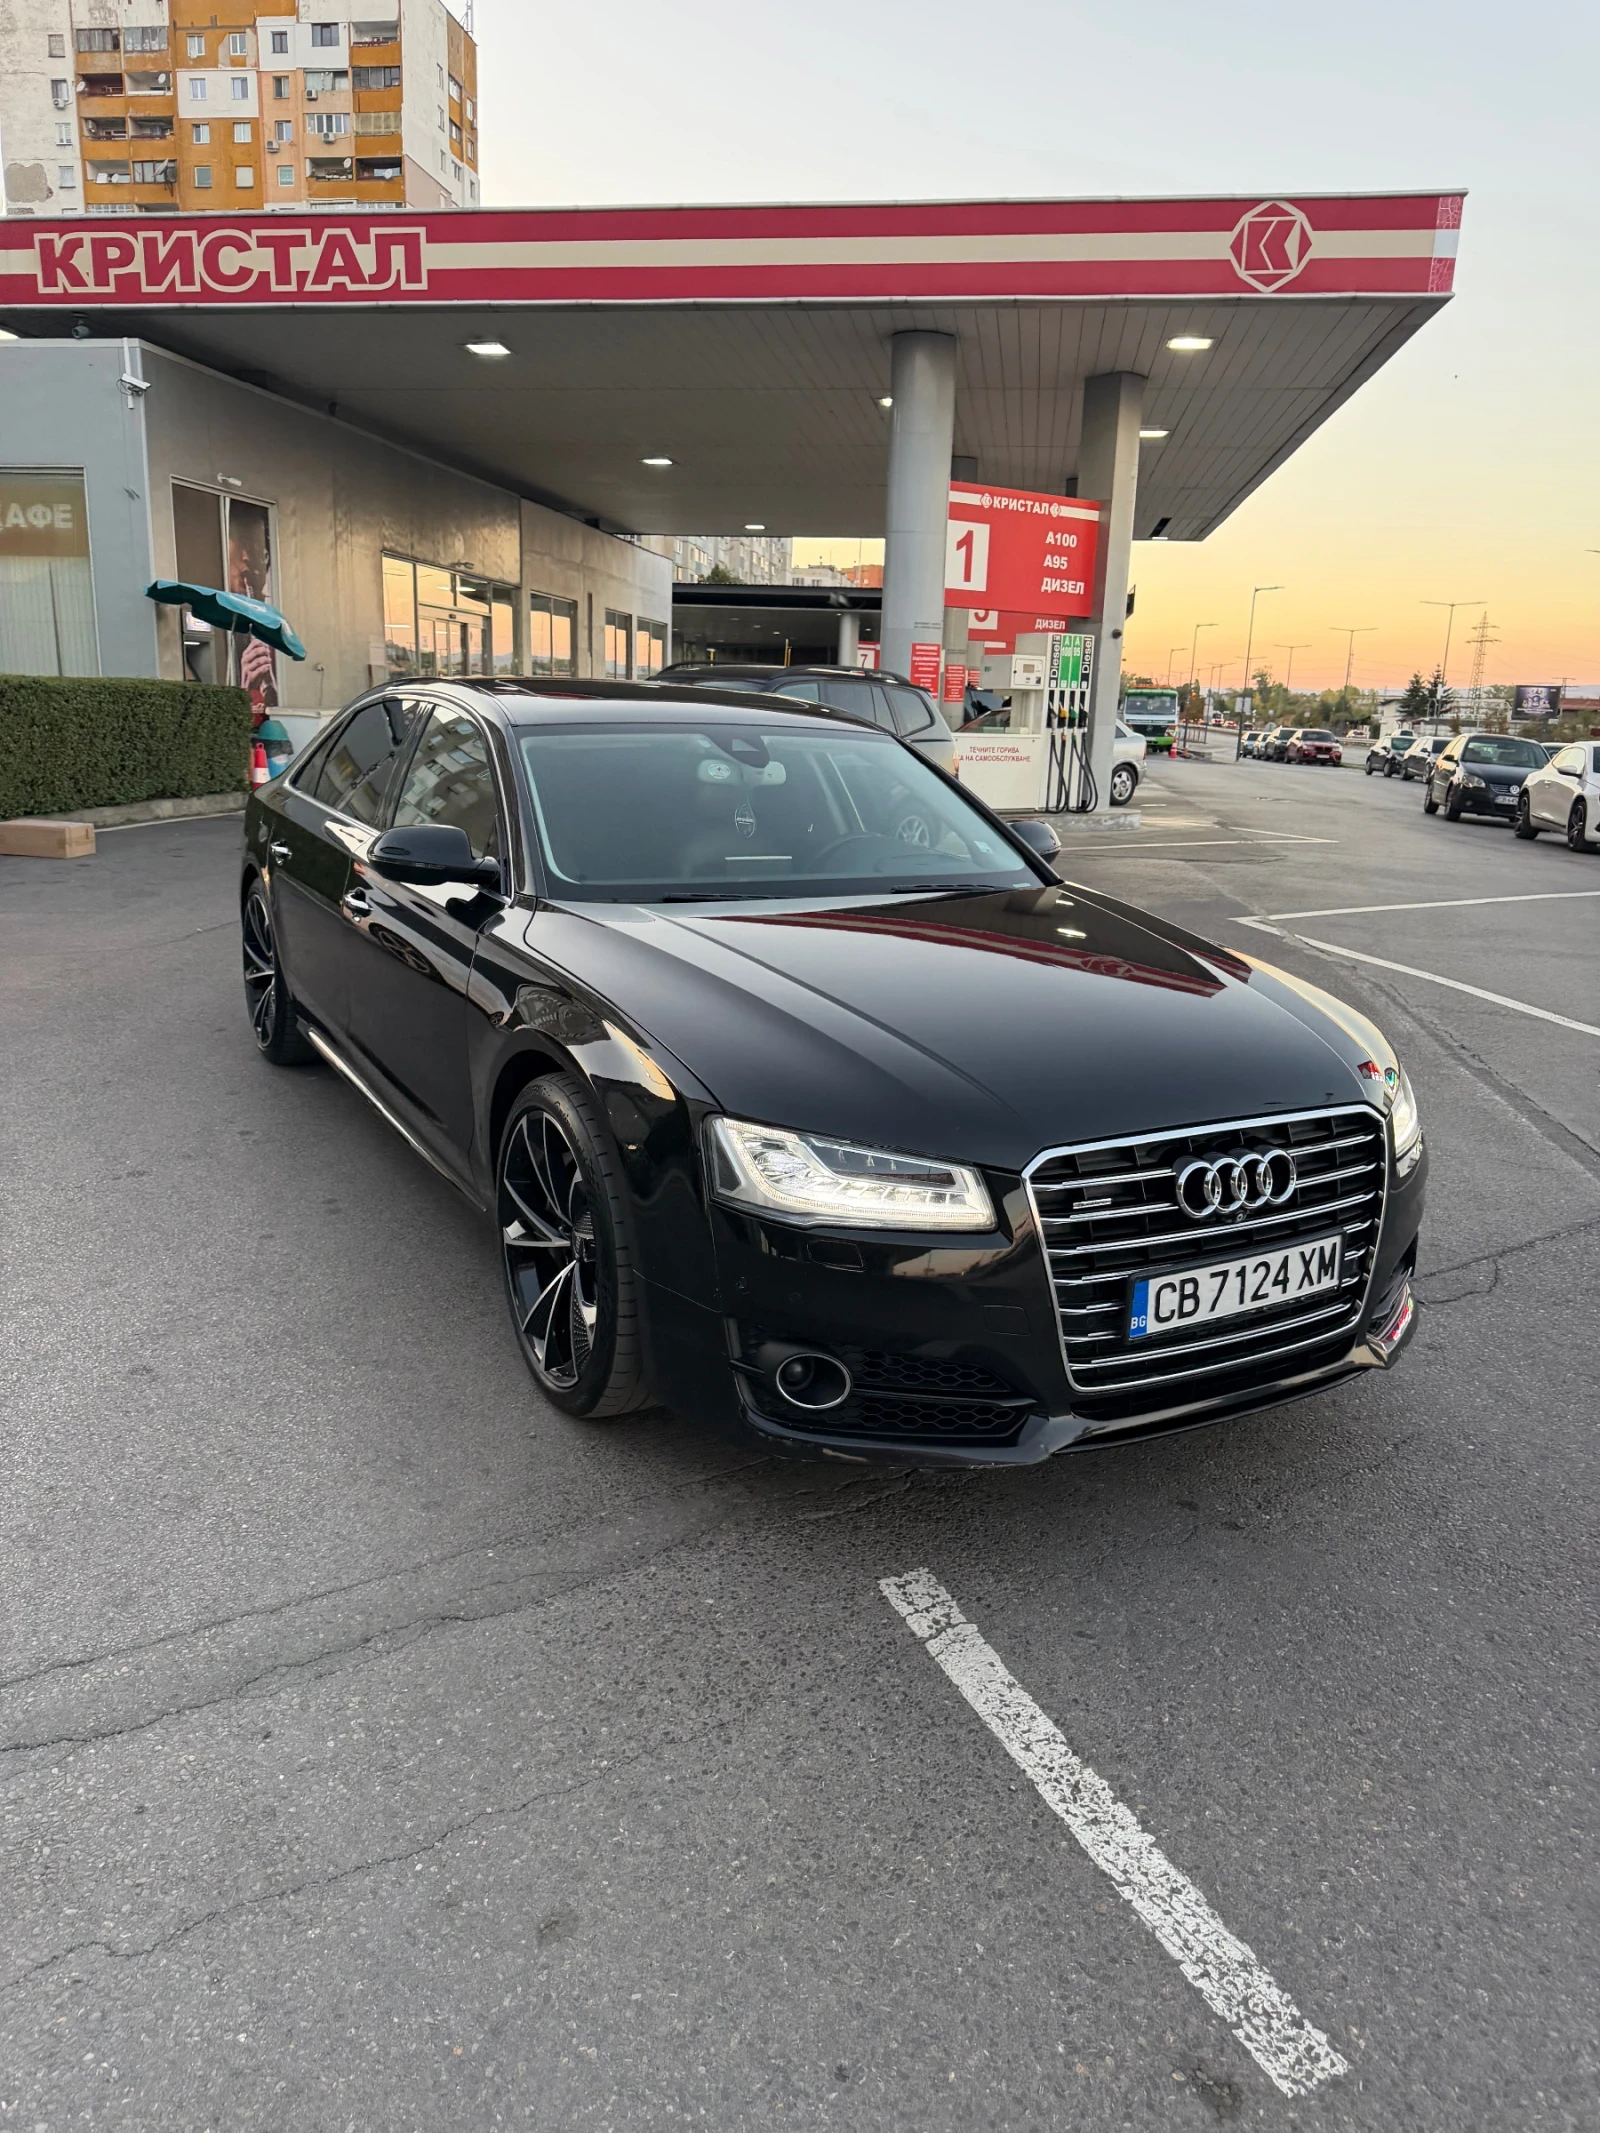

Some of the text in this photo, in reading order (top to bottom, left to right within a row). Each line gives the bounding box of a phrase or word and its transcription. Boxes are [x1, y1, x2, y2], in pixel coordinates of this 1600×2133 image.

[34, 227, 428, 293] КРИСТАЛ
[993, 496, 1049, 515] КРИСТАЛ
[956, 530, 974, 582] 1
[1041, 577, 1085, 595] ДИЗЕЛ
[1035, 618, 1066, 630] ДИЗЕЛ
[860, 654, 869, 668] 7
[1050, 642, 1060, 678] Diesel
[1082, 637, 1092, 674] Diesel
[1208, 1254, 1290, 1313] 7124
[1130, 1315, 1147, 1330] BG
